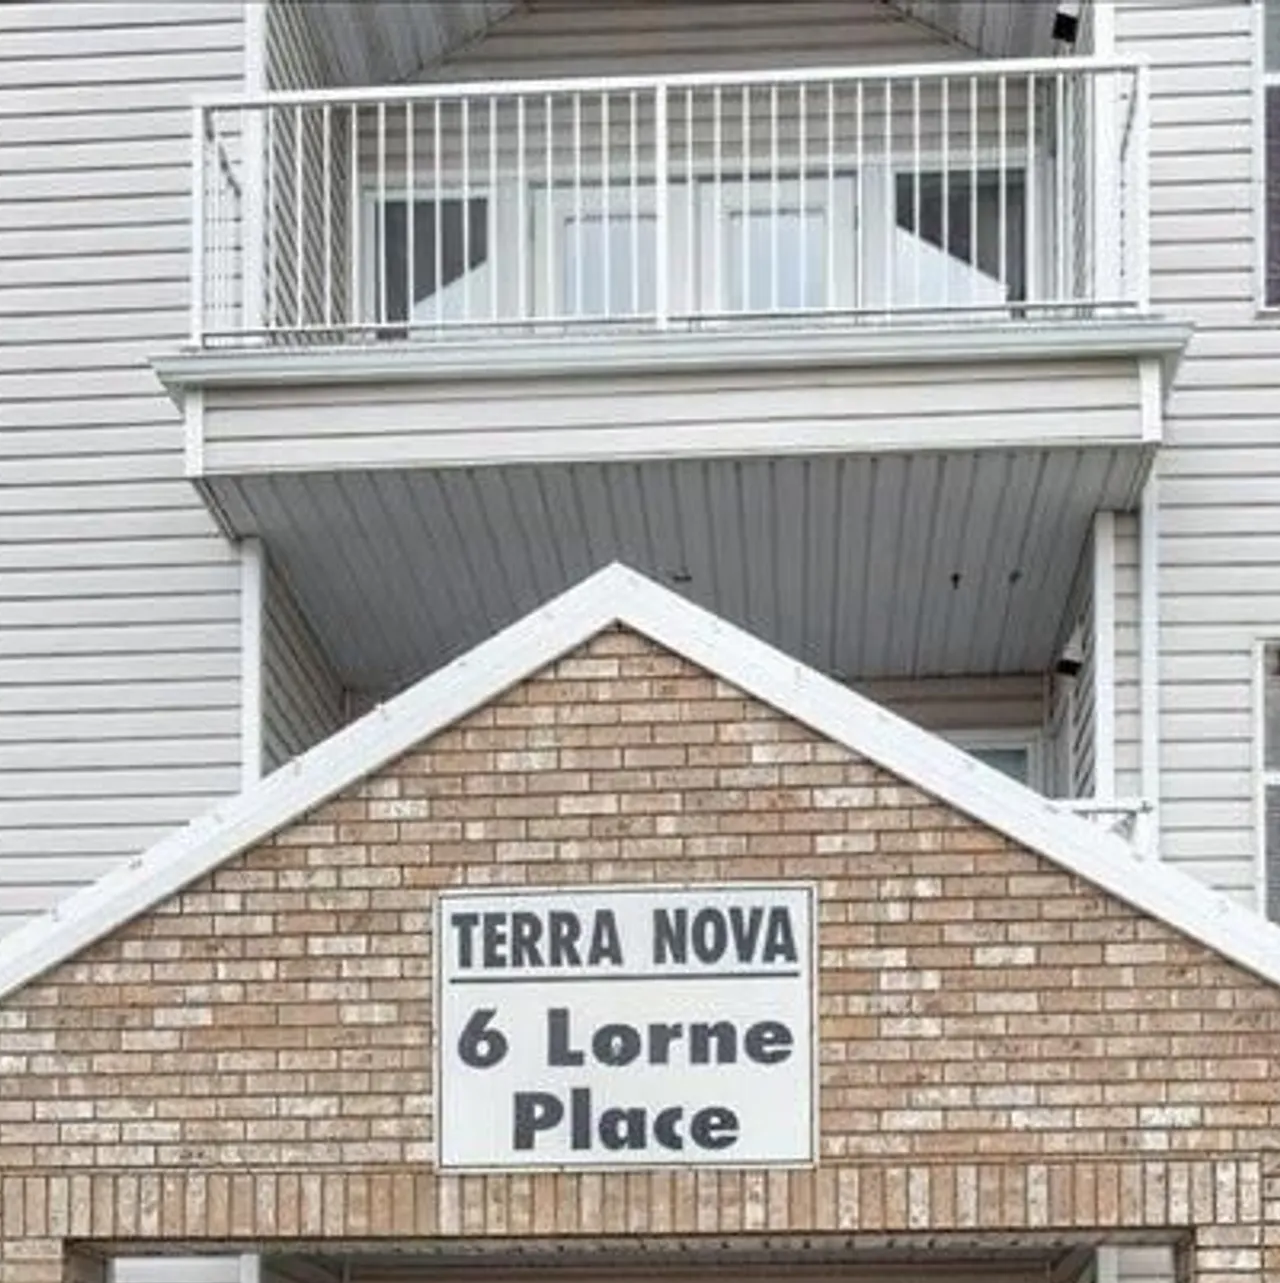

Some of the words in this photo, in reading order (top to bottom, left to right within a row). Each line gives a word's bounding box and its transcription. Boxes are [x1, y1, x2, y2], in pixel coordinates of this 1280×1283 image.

[451, 909, 623, 969] TERRA
[653, 907, 799, 965] NOVA
[457, 1008, 509, 1069] 6
[547, 1008, 794, 1066] Lorne
[512, 1087, 740, 1151] Place
